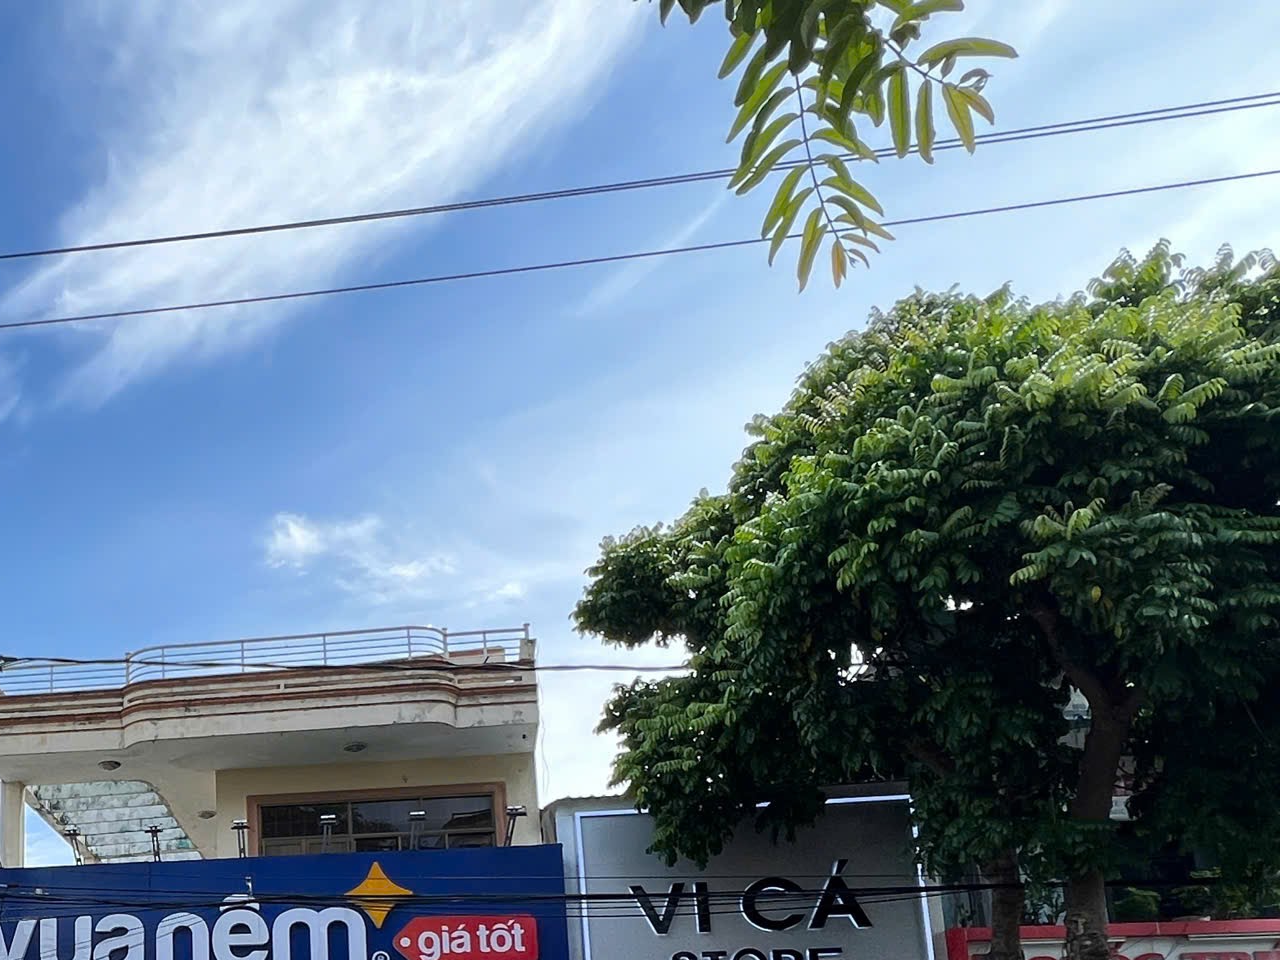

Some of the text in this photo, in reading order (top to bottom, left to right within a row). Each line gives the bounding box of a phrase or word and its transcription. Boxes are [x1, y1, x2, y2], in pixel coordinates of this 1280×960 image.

[629, 858, 873, 935] VI CÁ
[477, 920, 526, 953] tốt
